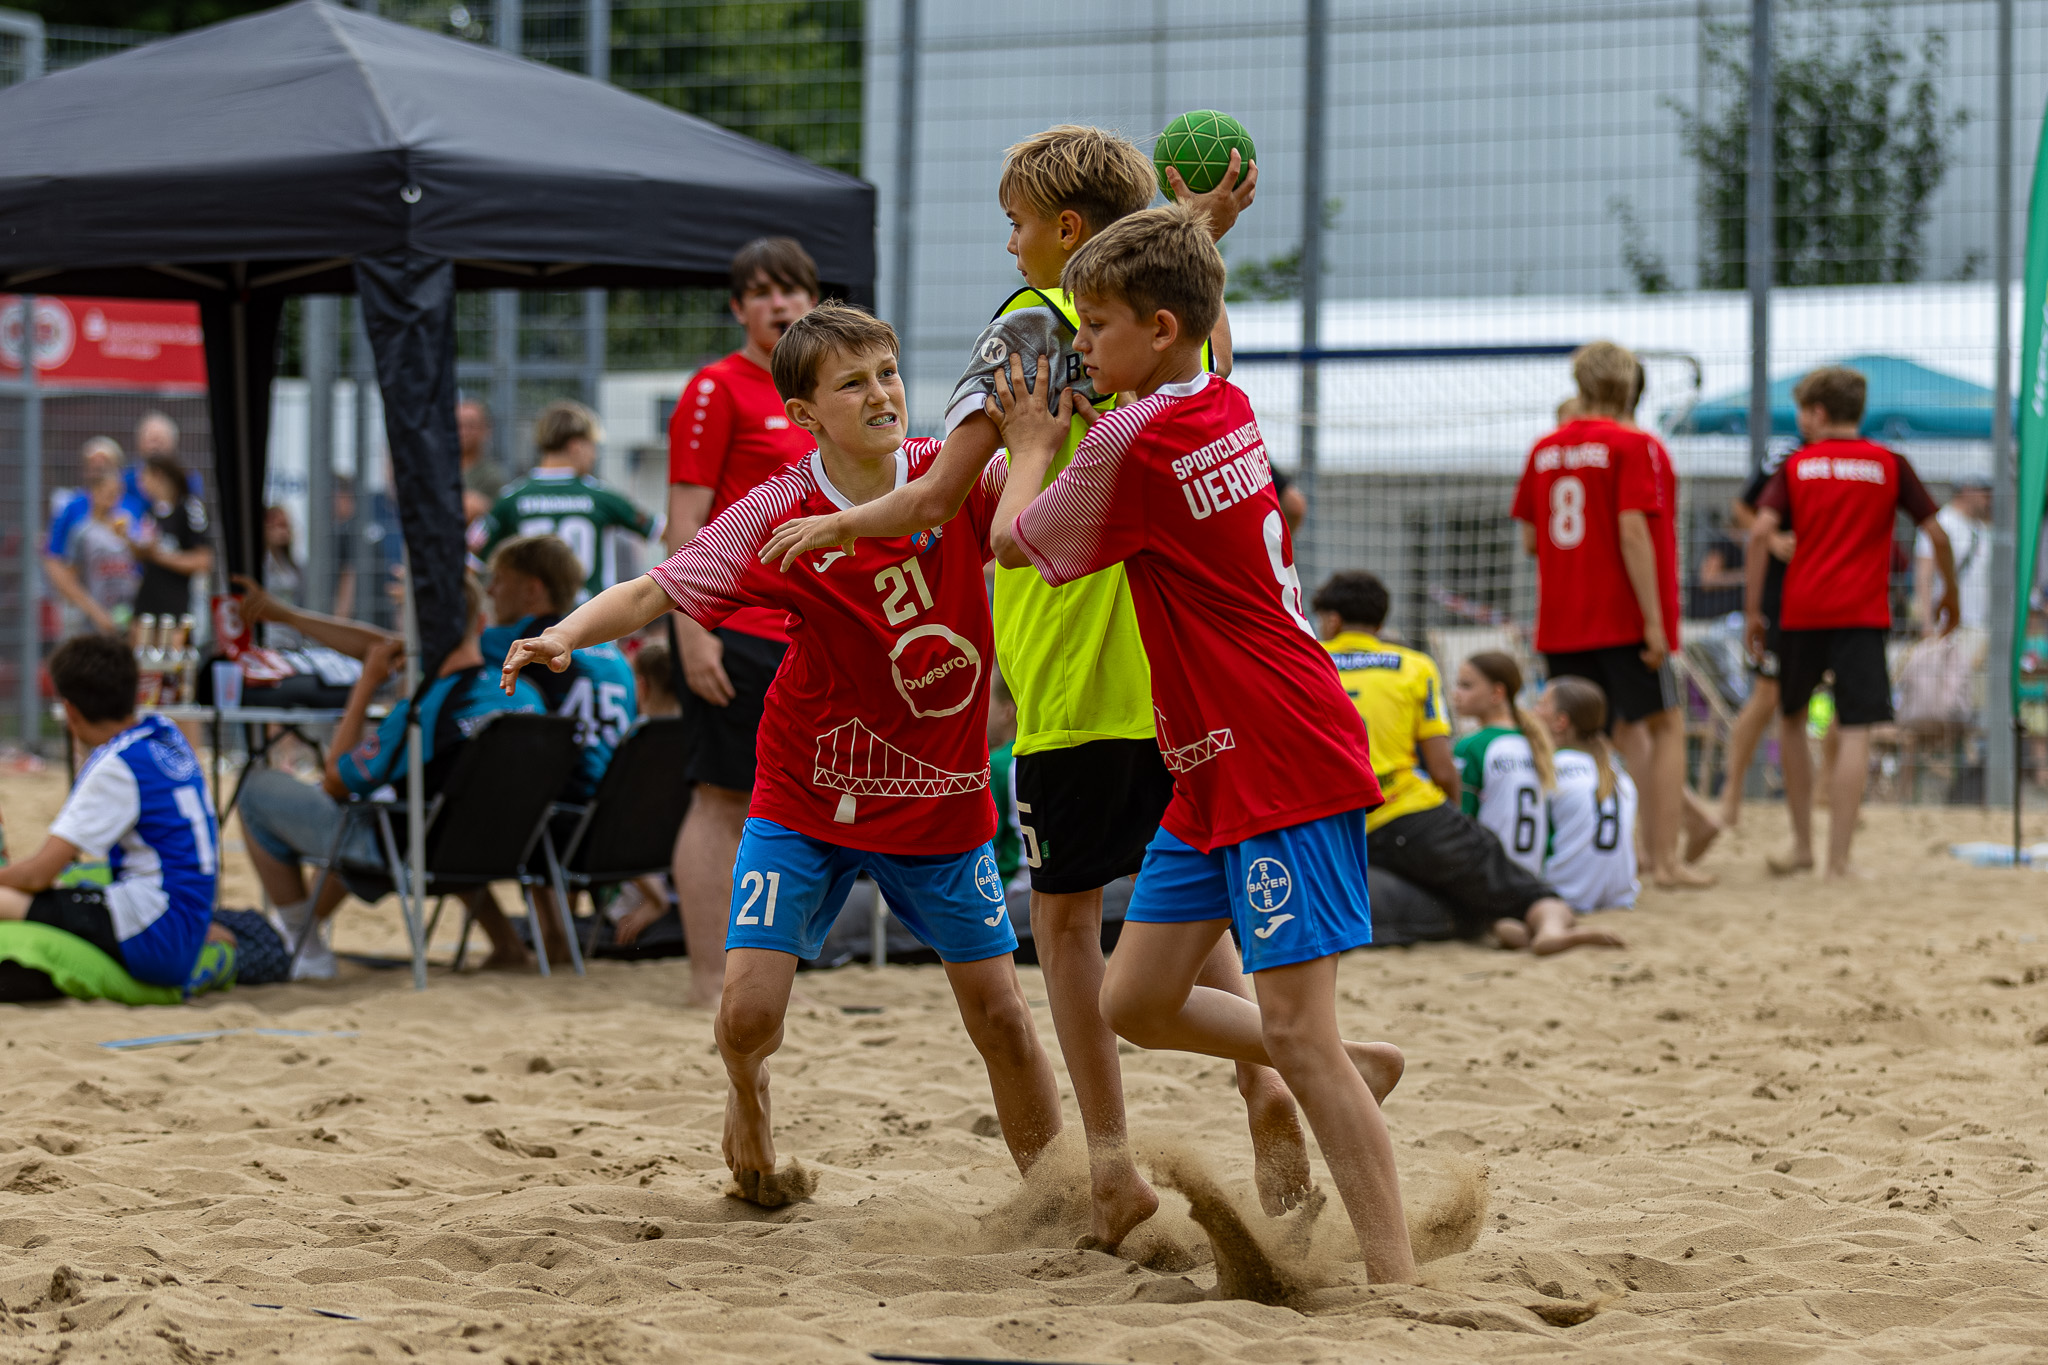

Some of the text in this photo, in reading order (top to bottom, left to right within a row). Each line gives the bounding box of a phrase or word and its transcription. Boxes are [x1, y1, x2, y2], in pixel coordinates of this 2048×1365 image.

[1171, 432, 1243, 481] SPORTCLUB
[1549, 474, 1586, 550] 8
[874, 556, 934, 626] 21
[557, 676, 632, 748] 45
[1514, 786, 1538, 853] 6
[736, 870, 780, 926] 21
[1249, 877, 1288, 893] BAYER
[1259, 862, 1273, 908] BAYER
